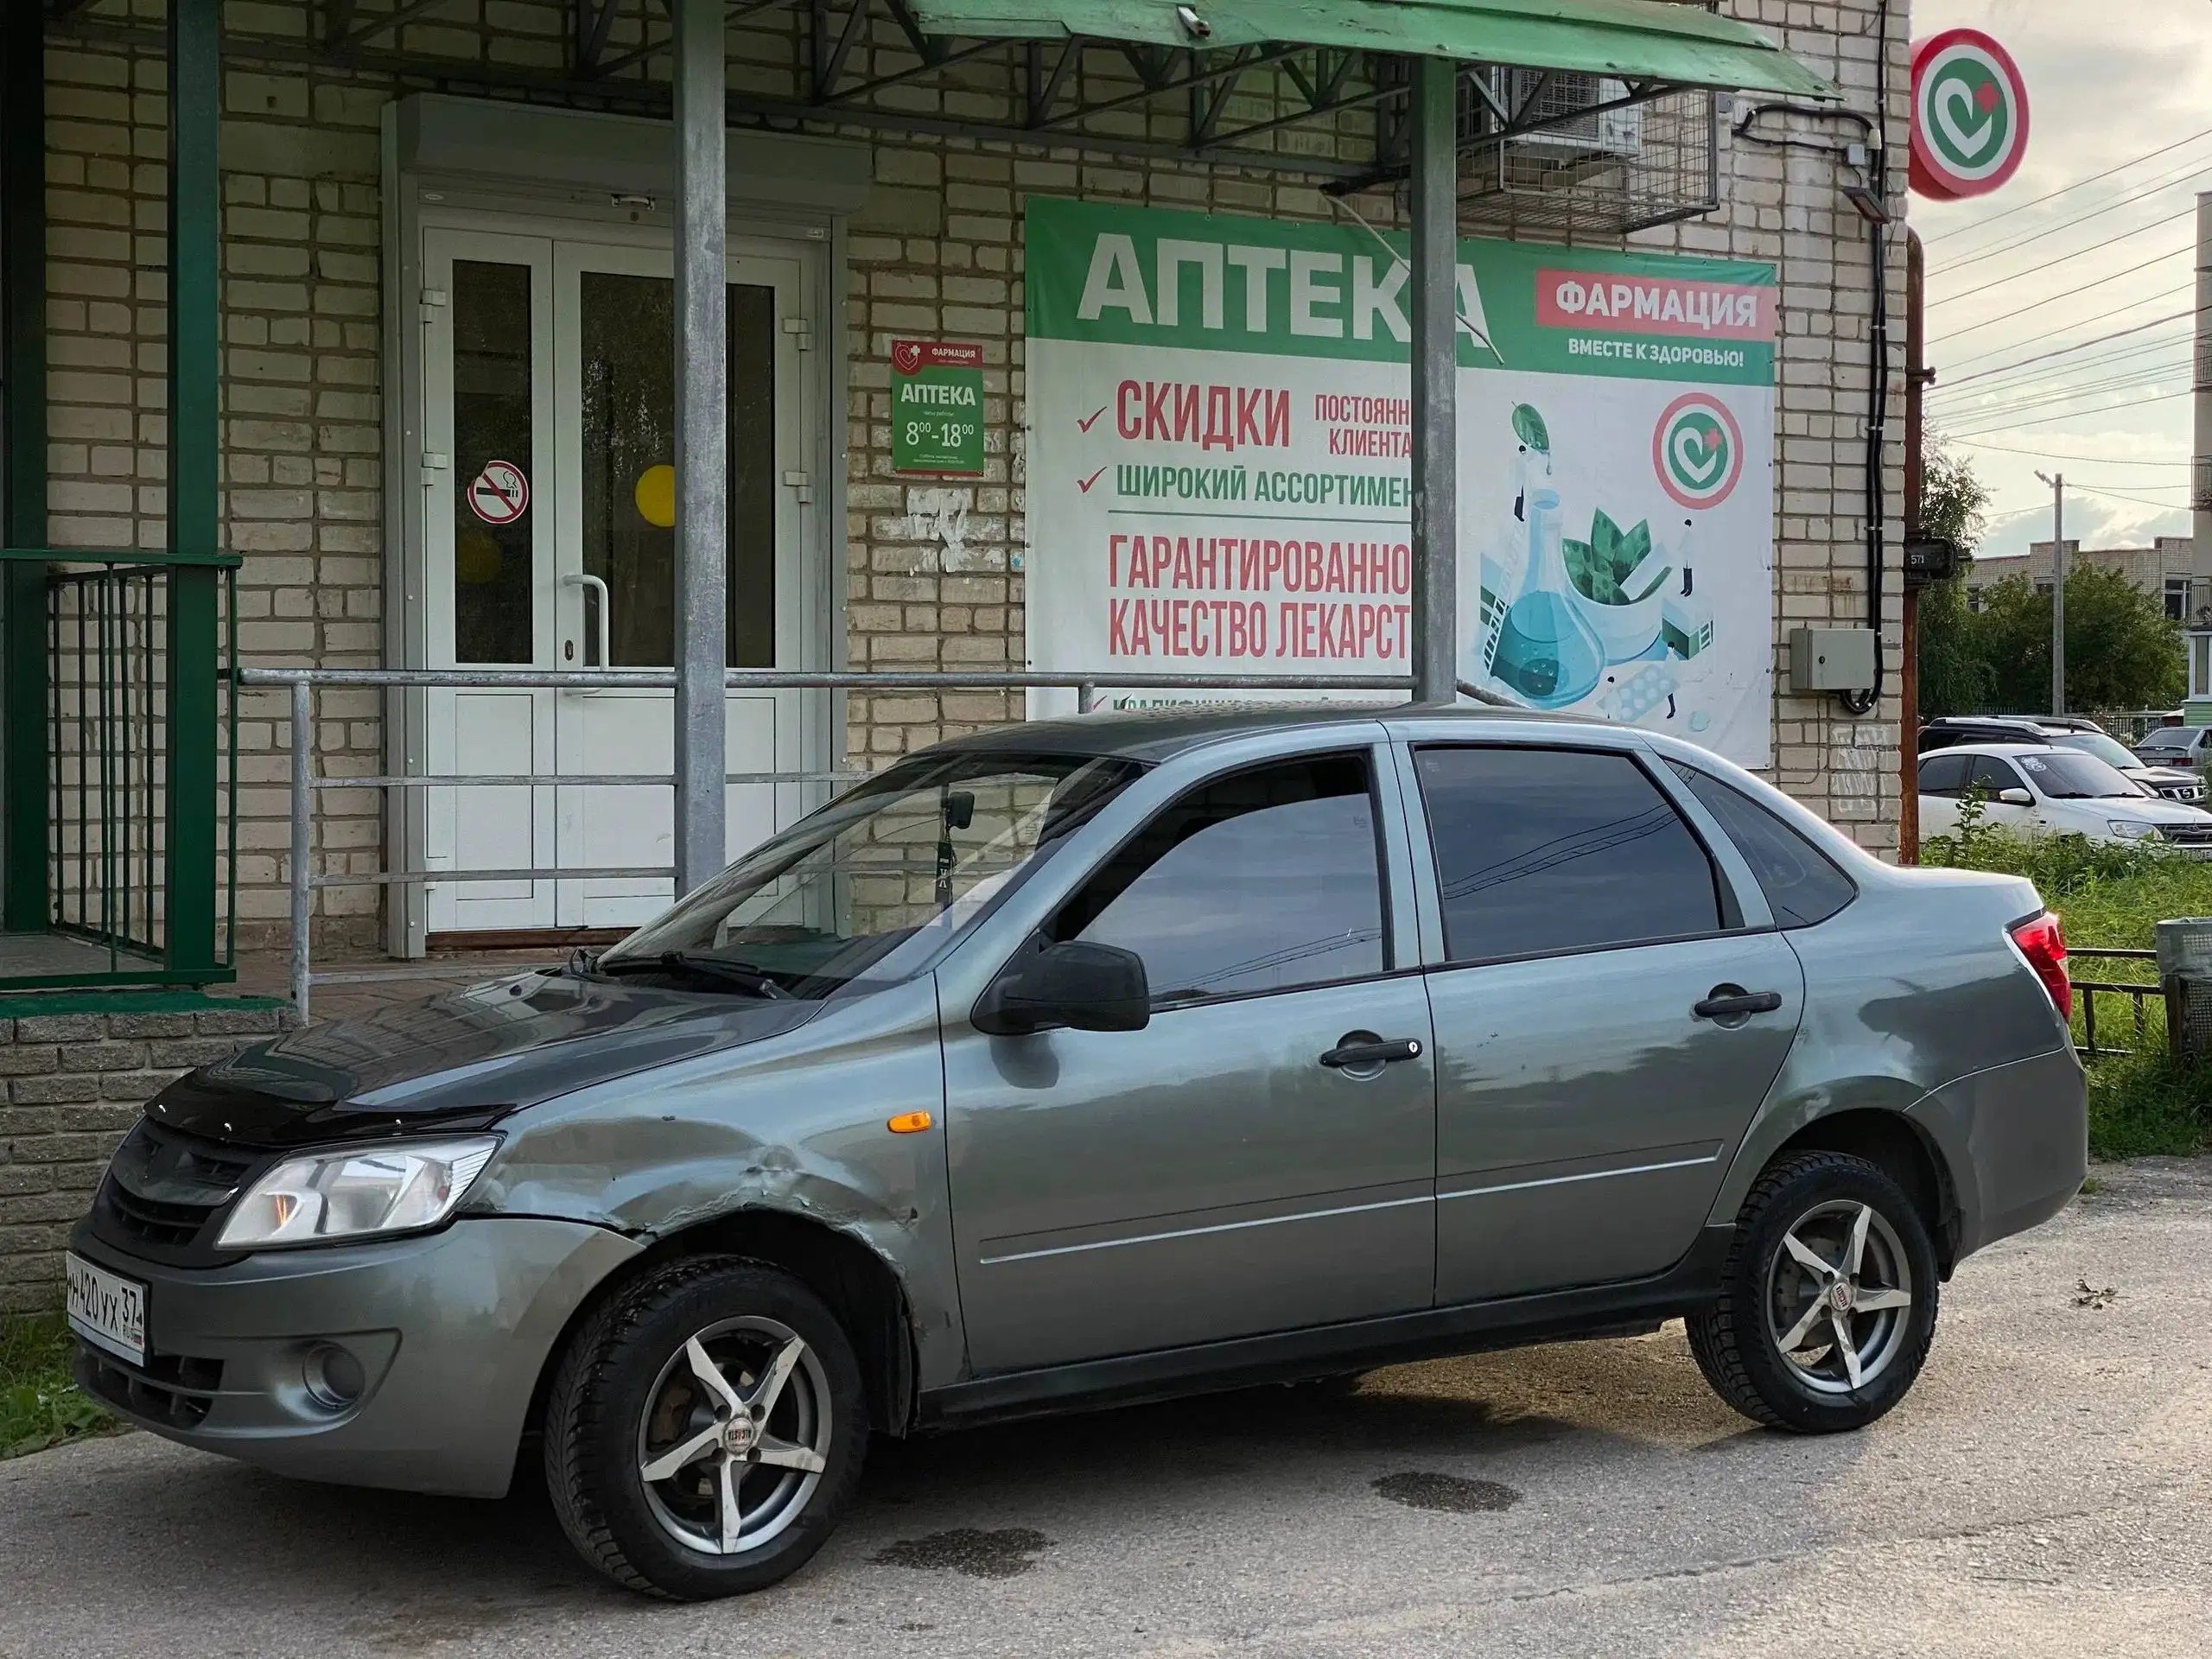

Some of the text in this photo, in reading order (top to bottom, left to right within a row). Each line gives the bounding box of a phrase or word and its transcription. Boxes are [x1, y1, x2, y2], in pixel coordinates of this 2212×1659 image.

[1556, 281, 1758, 330] ФАРМАЦИЯ
[931, 347, 976, 359] ФАРМАЦИЯ
[1568, 338, 1744, 366] ВМЕСТЕ К ЗДОРОВЬЮ!
[900, 383, 976, 406] АПТЕКА
[1116, 379, 1290, 452] СКИДКИ
[1116, 464, 1247, 500] ШИРОКИЙ
[1109, 598, 1268, 657] КАЧЕСТВО
[121, 1286, 137, 1327] 37
